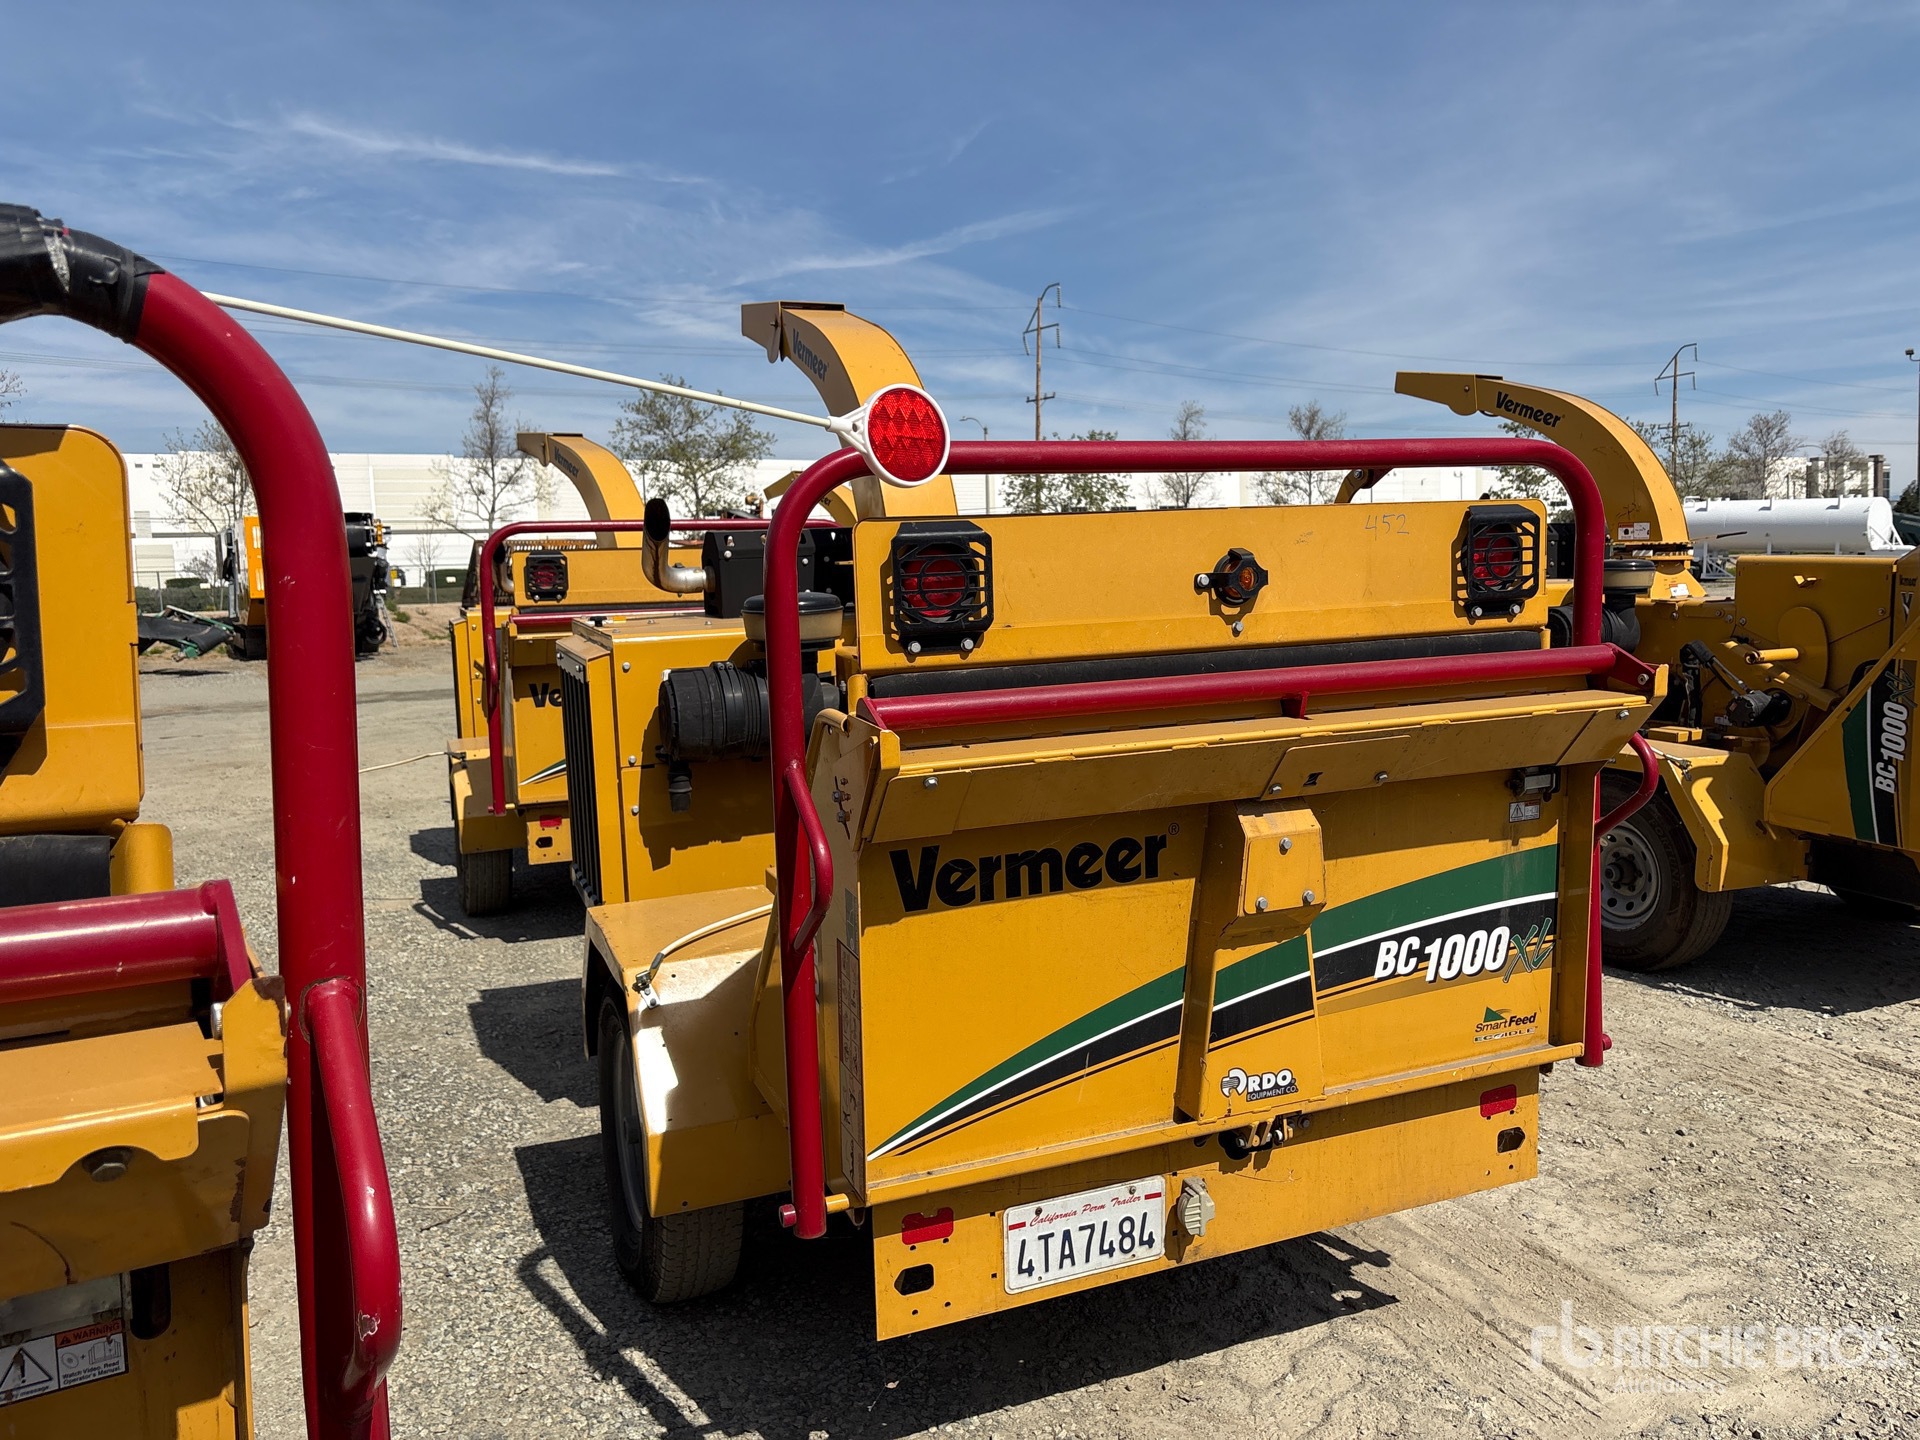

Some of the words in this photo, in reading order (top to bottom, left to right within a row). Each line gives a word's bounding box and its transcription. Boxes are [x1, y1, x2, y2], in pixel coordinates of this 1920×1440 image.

[792, 328, 828, 382] Vermeer
[1496, 391, 1561, 427] Vermeer
[1365, 514, 1409, 541] 452
[1247, 1087, 1285, 1101] EQUIPMENT
[1029, 1209, 1077, 1227] California
[1081, 1203, 1106, 1214] Perm
[1111, 1195, 1141, 1207] Trailer
[1018, 1212, 1155, 1277] 4TA7484
[72, 1322, 121, 1340] WARNING
